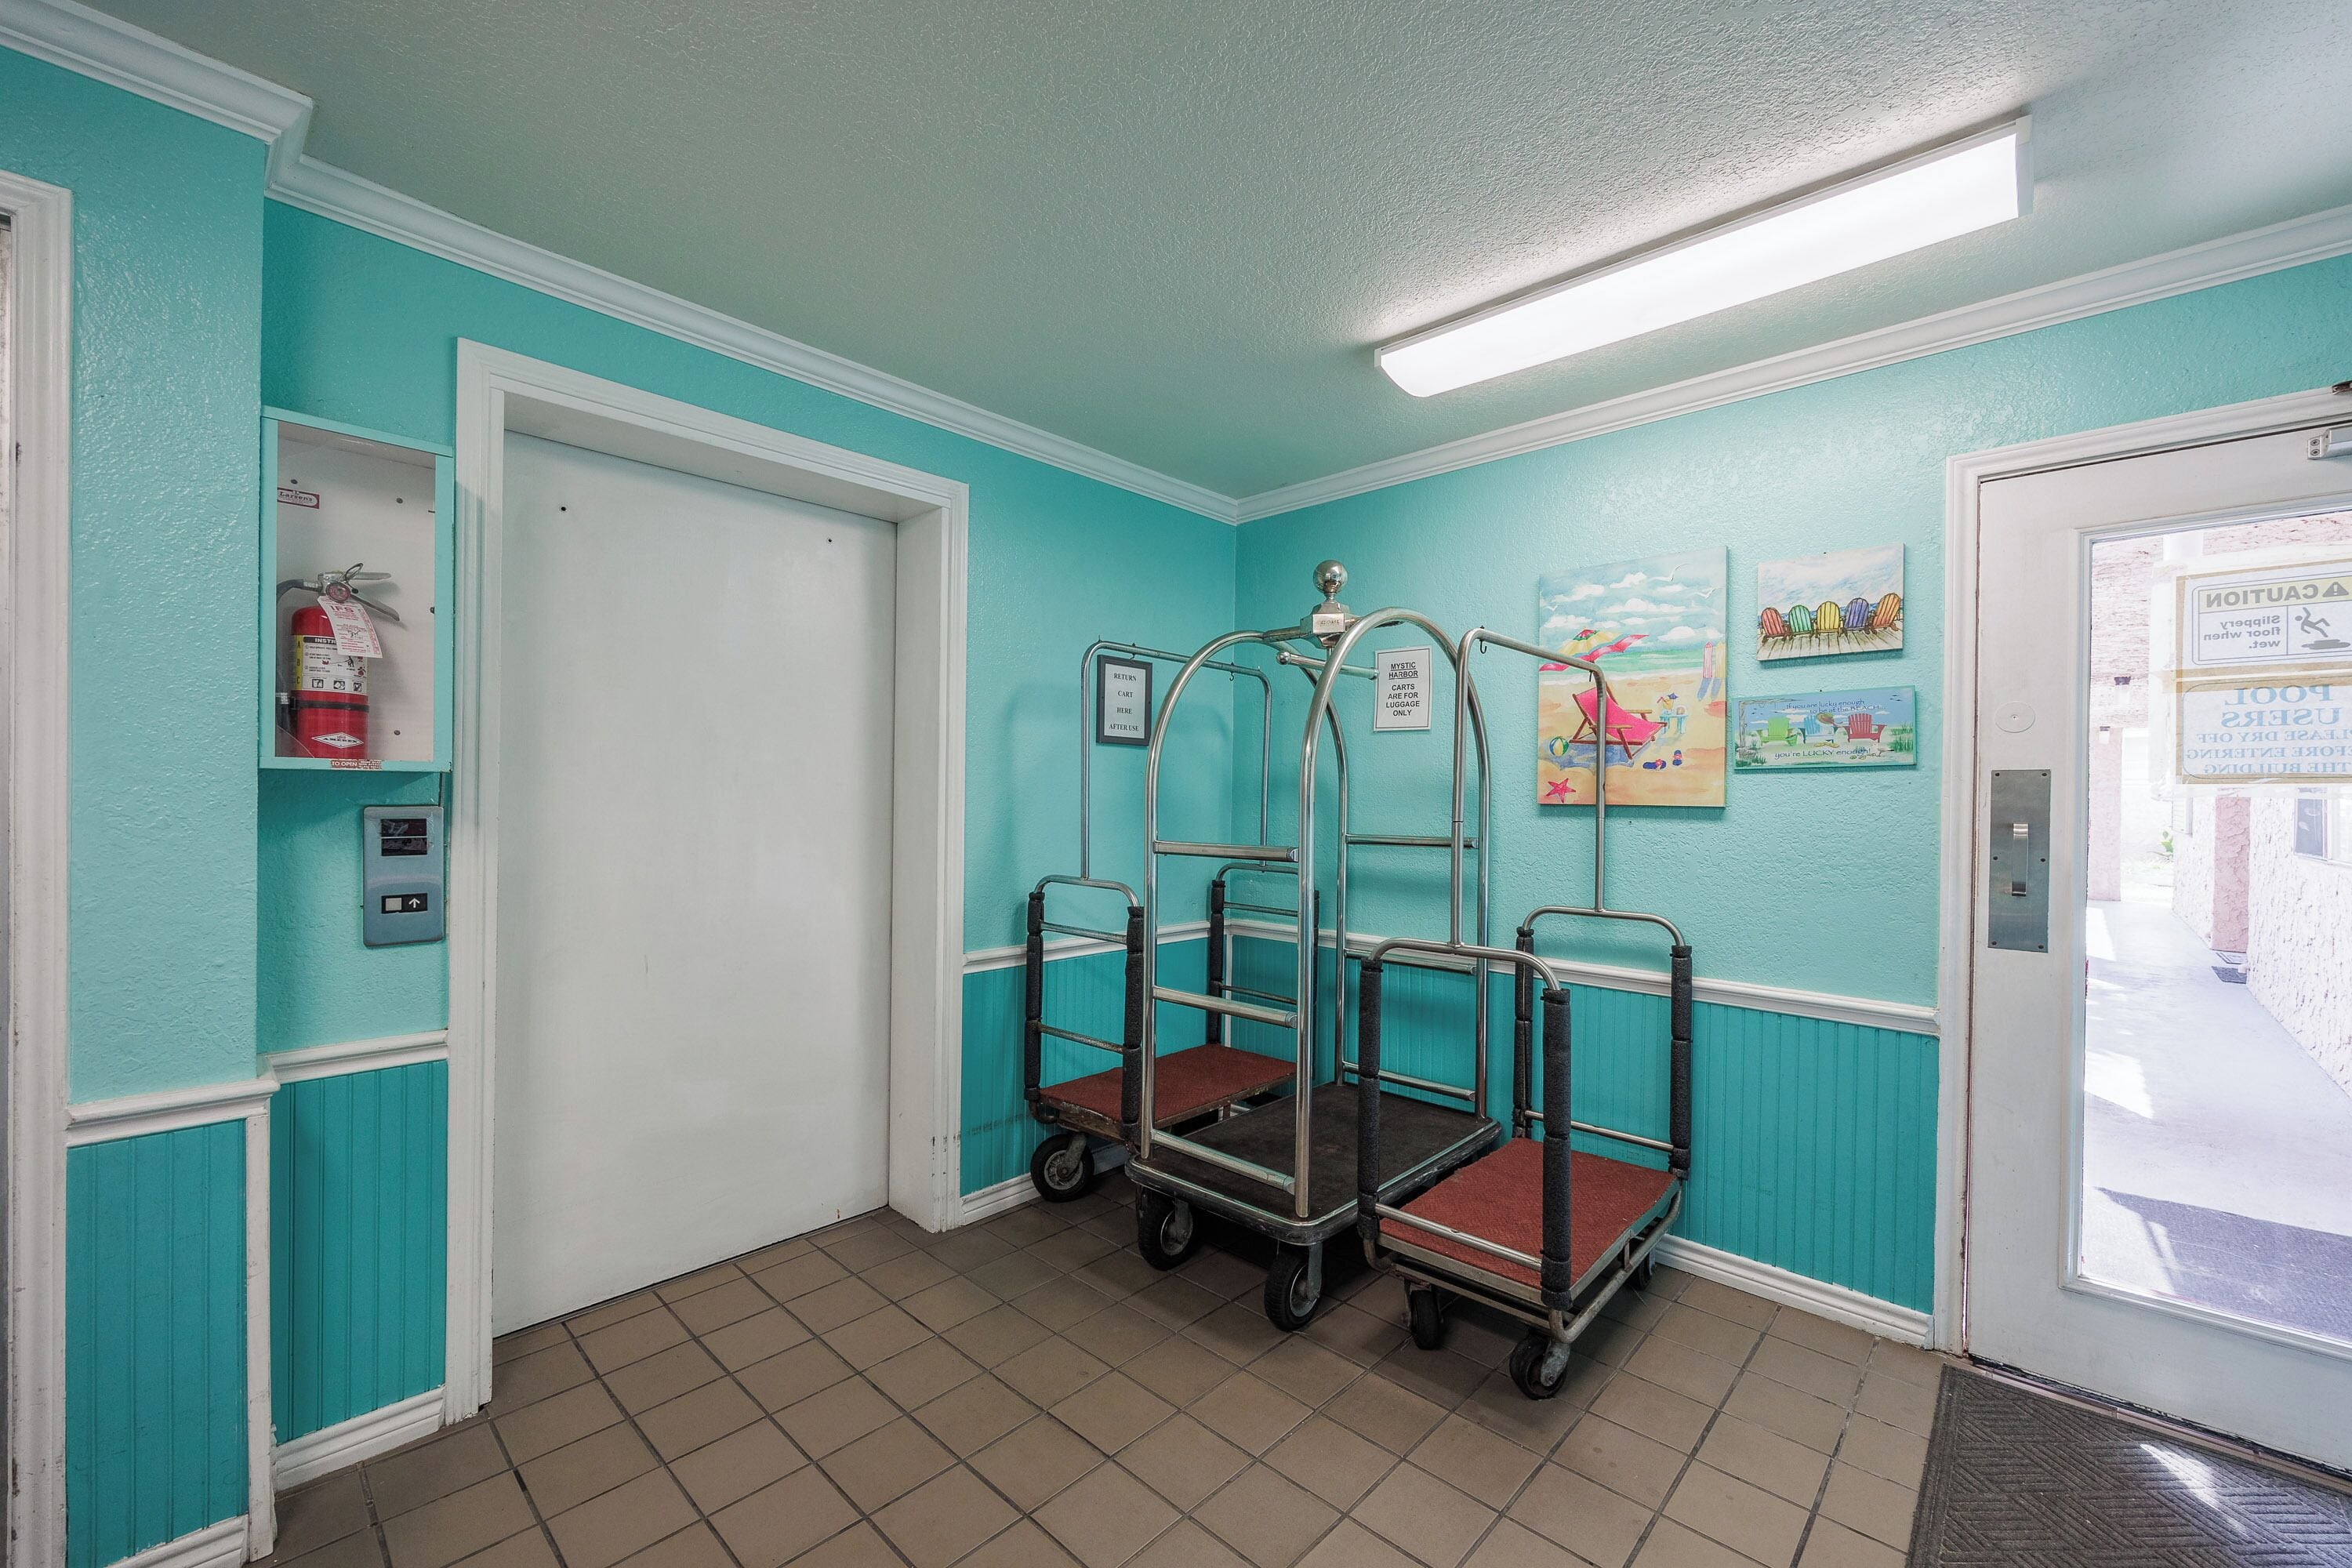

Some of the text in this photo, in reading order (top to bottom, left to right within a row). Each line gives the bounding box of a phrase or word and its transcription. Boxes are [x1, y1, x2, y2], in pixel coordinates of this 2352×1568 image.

[279, 492, 313, 502] Larsen's
[1390, 662, 1416, 670] MYSTIC
[1113, 673, 1137, 681] RETURN
[1388, 670, 1418, 679] HARBOR
[1774, 751, 1801, 760] you're
